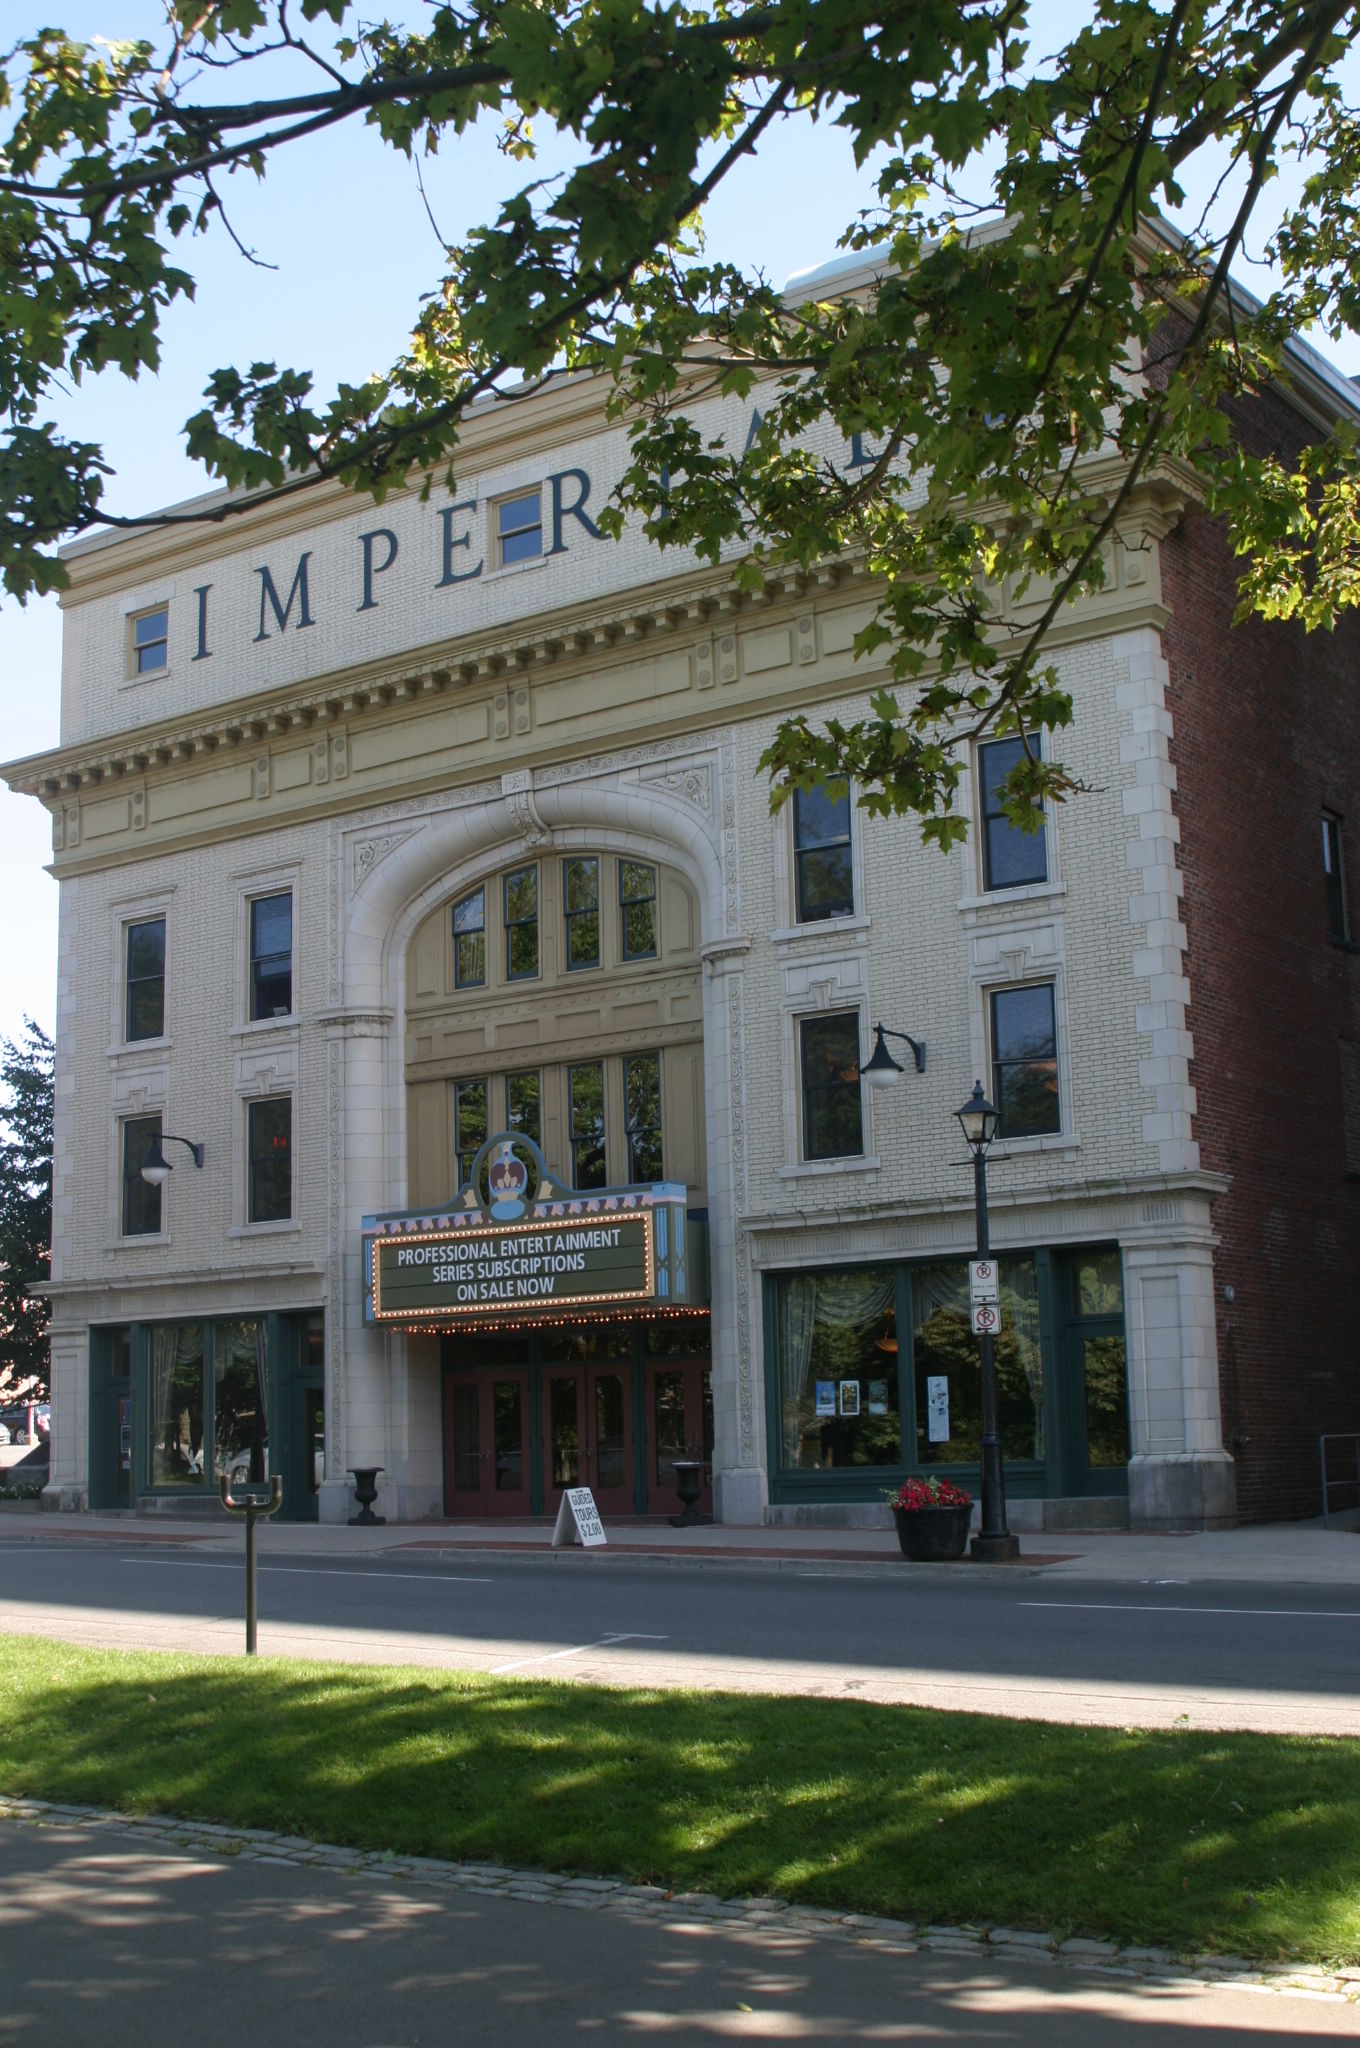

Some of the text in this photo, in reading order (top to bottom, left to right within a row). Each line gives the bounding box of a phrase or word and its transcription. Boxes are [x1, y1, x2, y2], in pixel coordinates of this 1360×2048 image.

[190, 407, 901, 662] IMPERL
[398, 1242, 496, 1265] PROFESSIONAL
[432, 1253, 585, 1283] SERIES SUBSCRIPTIONS
[457, 1277, 555, 1301] ON SALE NOW
[572, 1494, 592, 1505] GUIDED
[575, 1507, 598, 1521] TOURS
